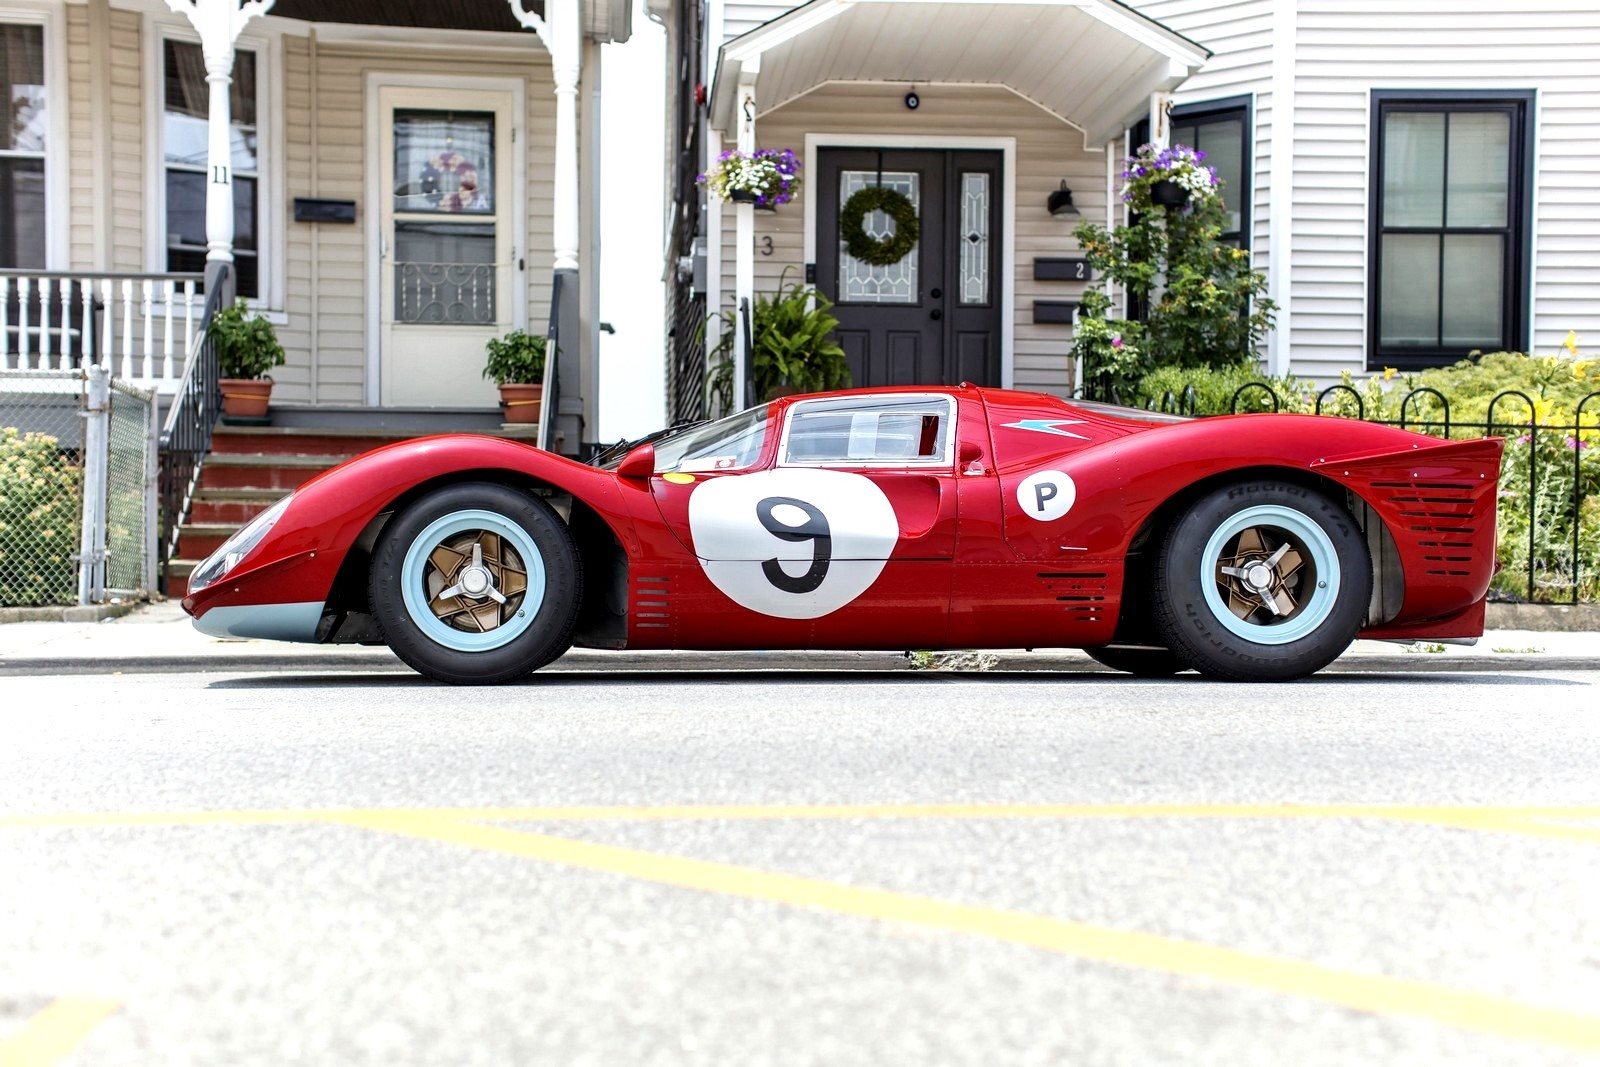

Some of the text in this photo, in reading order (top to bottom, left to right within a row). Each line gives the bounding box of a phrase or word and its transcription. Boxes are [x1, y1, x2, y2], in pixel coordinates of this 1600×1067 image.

[212, 165, 229, 185] 11
[1076, 262, 1084, 278] 2
[1034, 482, 1058, 512] P
[756, 496, 832, 594] 9
